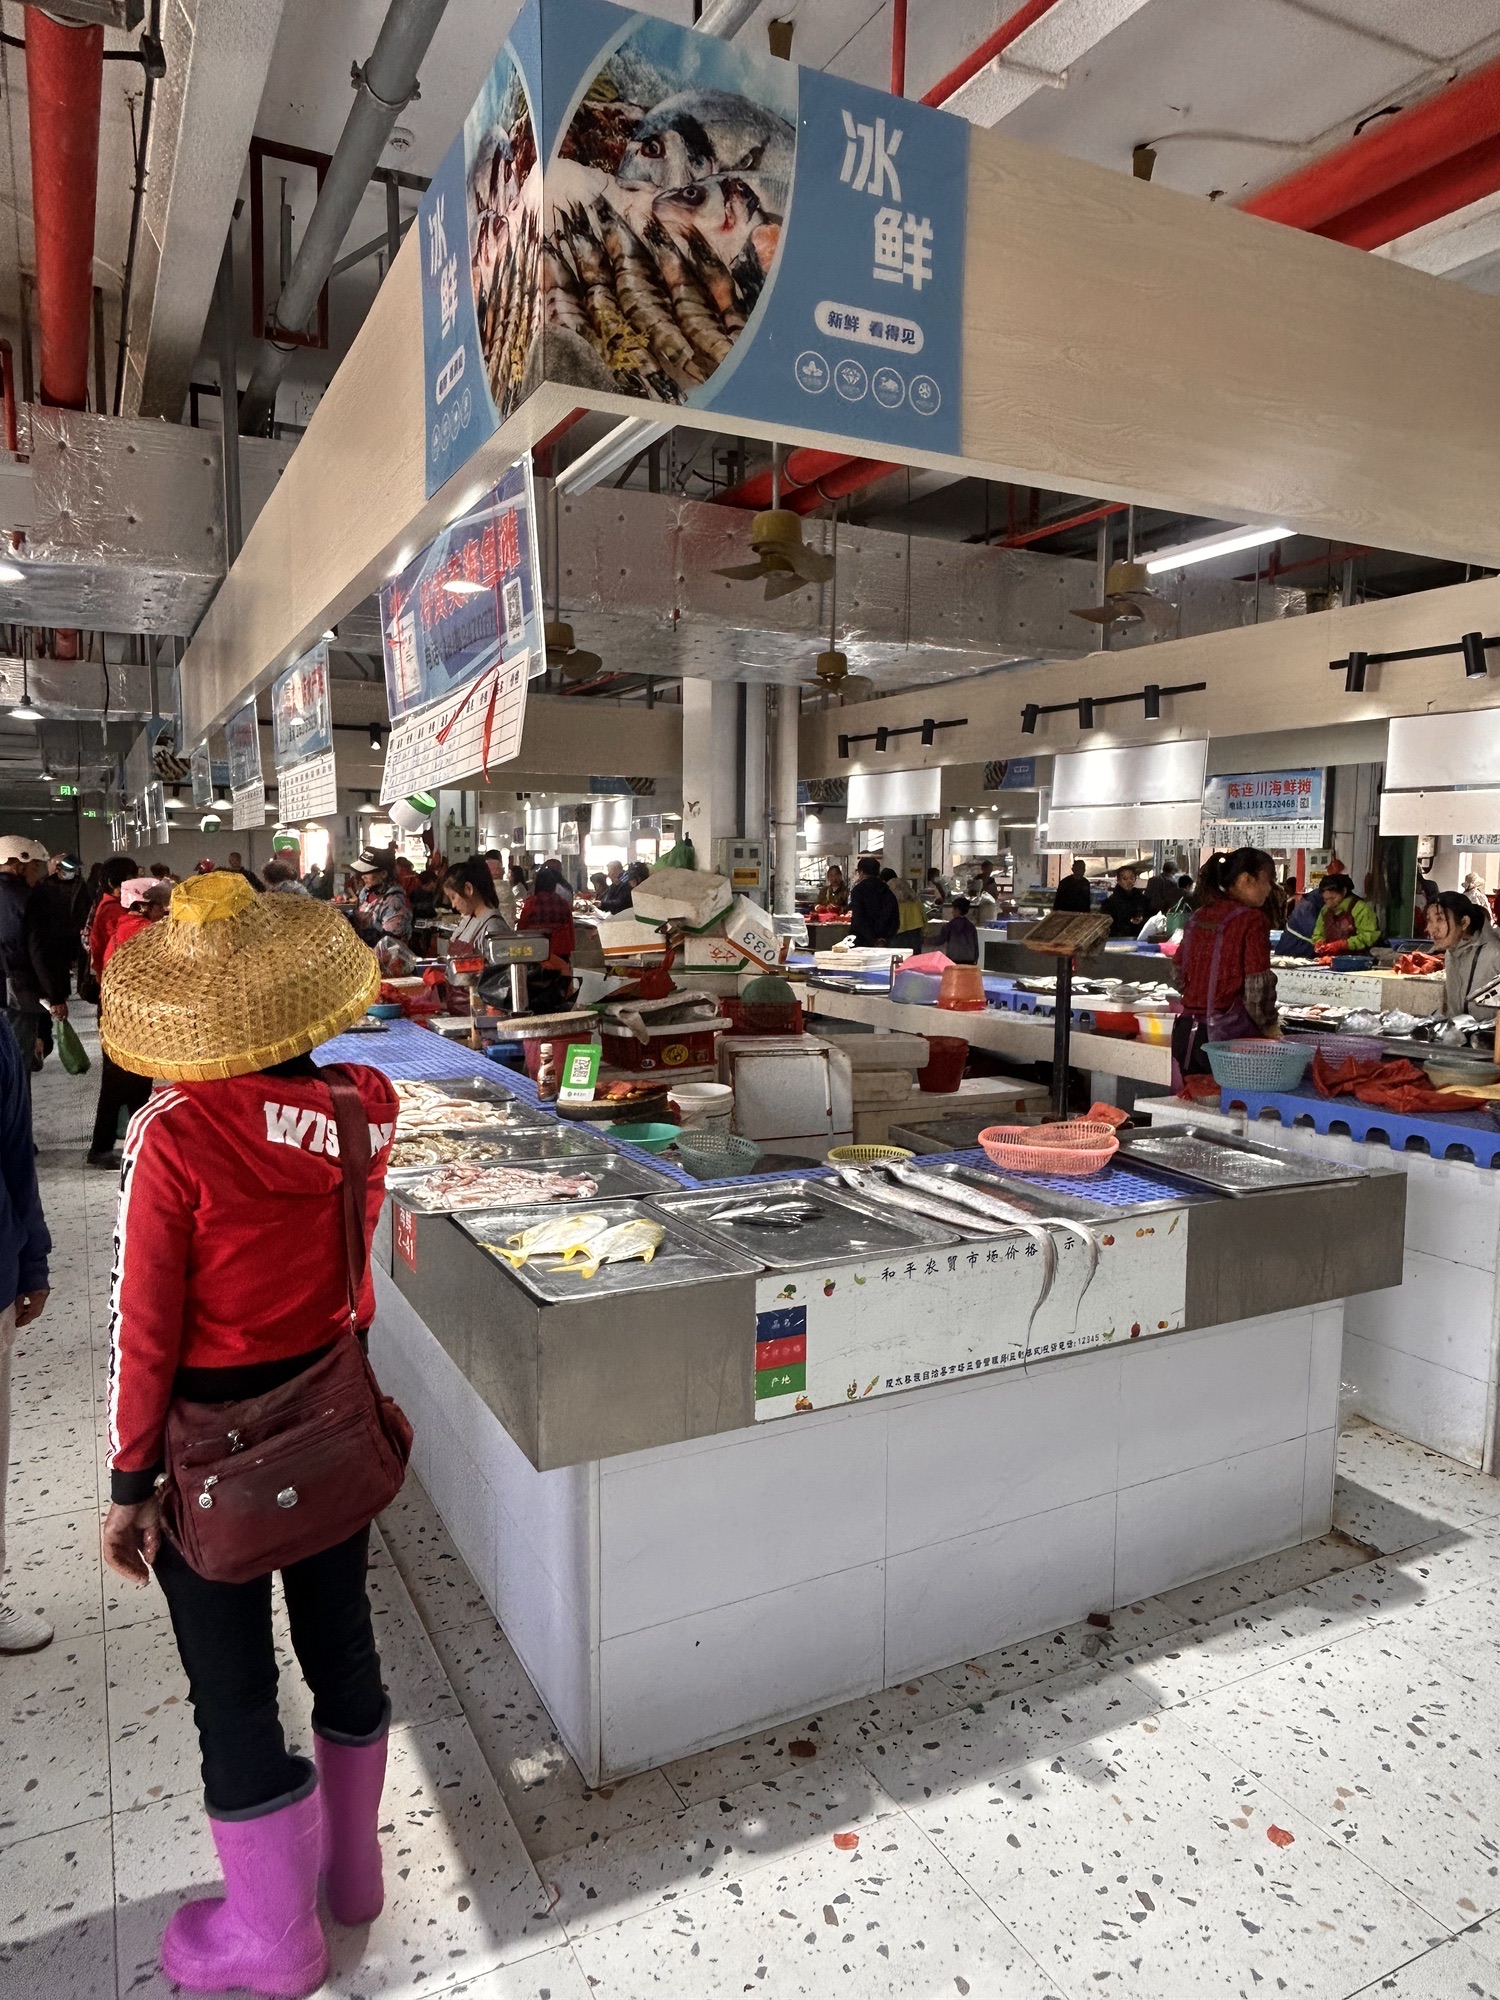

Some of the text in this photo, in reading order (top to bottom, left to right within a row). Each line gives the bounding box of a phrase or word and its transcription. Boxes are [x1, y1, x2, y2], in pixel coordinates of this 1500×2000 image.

[839, 109, 934, 291] 冰鲜
[827, 310, 916, 345] 新鲜 看得见
[1227, 777, 1312, 799] 陈连川海鲜摊
[743, 932, 776, 962] 033
[771, 1374, 791, 1388] 产地
